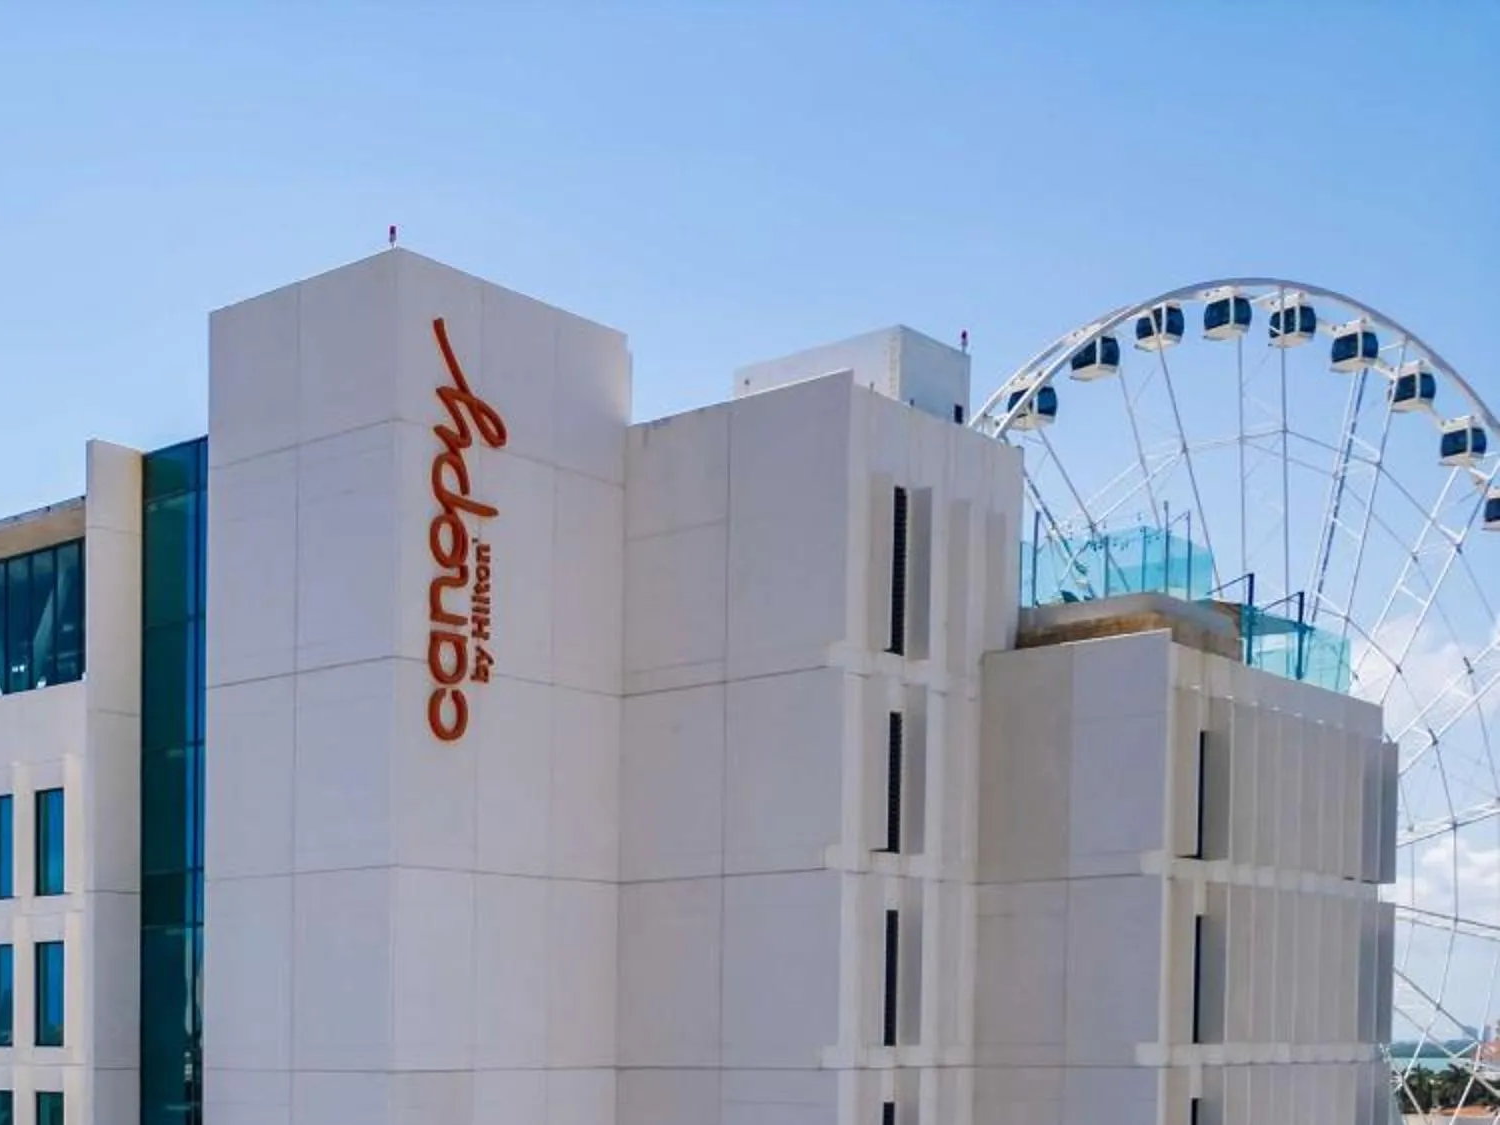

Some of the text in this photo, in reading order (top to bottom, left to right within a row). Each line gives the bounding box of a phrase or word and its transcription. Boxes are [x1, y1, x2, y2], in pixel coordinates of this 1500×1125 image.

[428, 317, 506, 741] canopy
[471, 543, 494, 683] by Hilton
